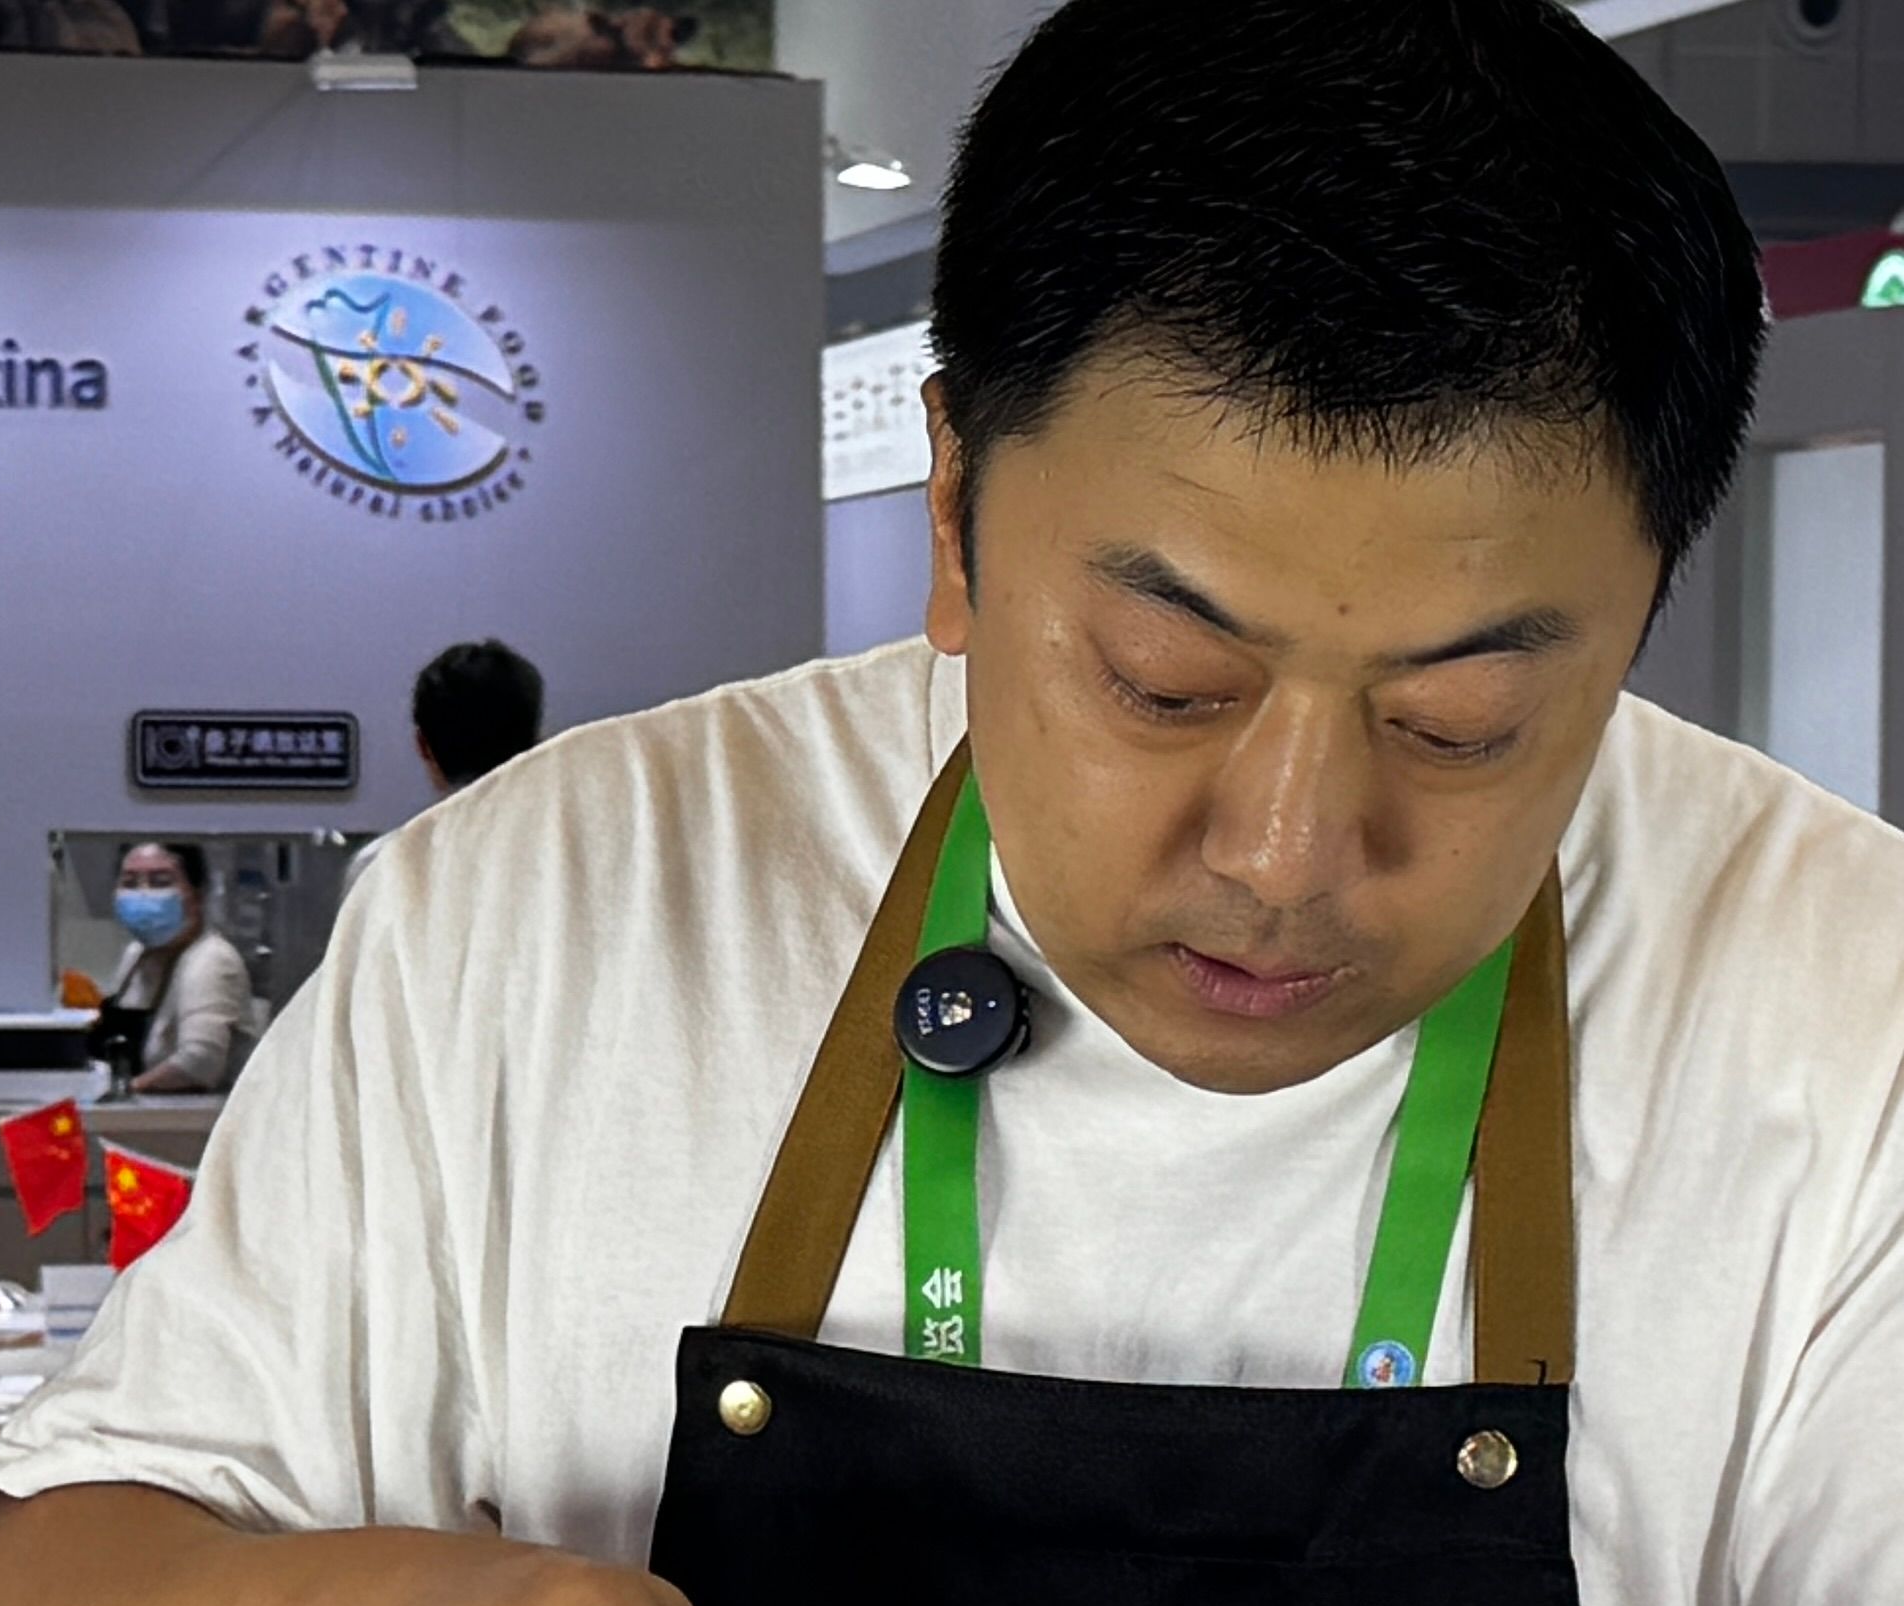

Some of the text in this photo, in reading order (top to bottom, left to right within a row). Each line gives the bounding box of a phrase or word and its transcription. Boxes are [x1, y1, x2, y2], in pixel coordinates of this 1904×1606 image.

[233, 242, 545, 422] ARGENTINE FOOD
[274, 434, 402, 519] Natural
